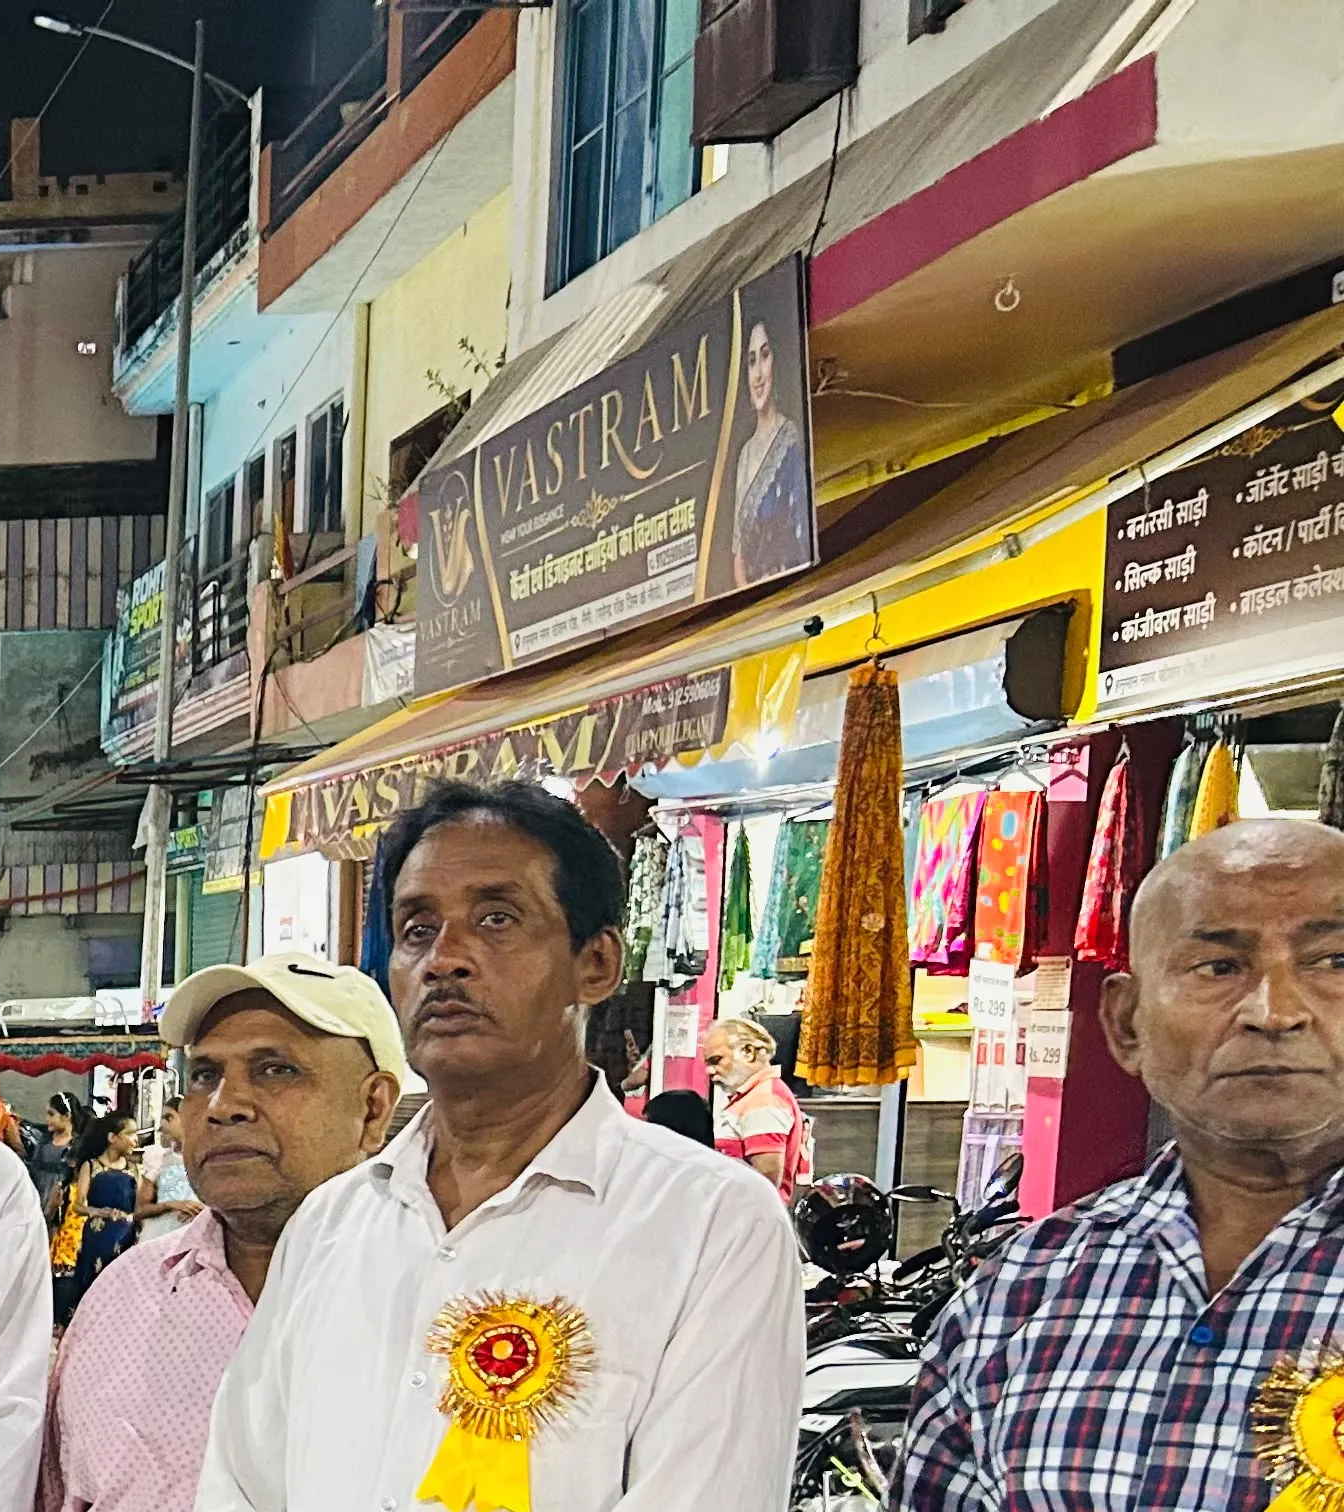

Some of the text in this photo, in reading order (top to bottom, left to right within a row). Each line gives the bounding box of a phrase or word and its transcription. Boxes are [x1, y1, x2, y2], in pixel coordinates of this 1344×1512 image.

[493, 334, 711, 518] VASTRAM
[1245, 463, 1290, 503] जॉर्जेट
[1292, 450, 1328, 493] साड़ी
[618, 526, 633, 557] का
[633, 513, 668, 552] विशाल
[668, 496, 696, 537] संग्रह
[1127, 487, 1210, 540] बनारसी साड़ी
[1243, 523, 1285, 560] कॉटन
[1297, 504, 1333, 544] पार्टी
[1124, 544, 1197, 593] सिल्क साड़ी
[1121, 592, 1217, 643] कांजीवरम साड़ी
[1240, 579, 1291, 616] ब्राइडल
[987, 999, 1006, 1018] 299
[1042, 1046, 1061, 1064] 299
